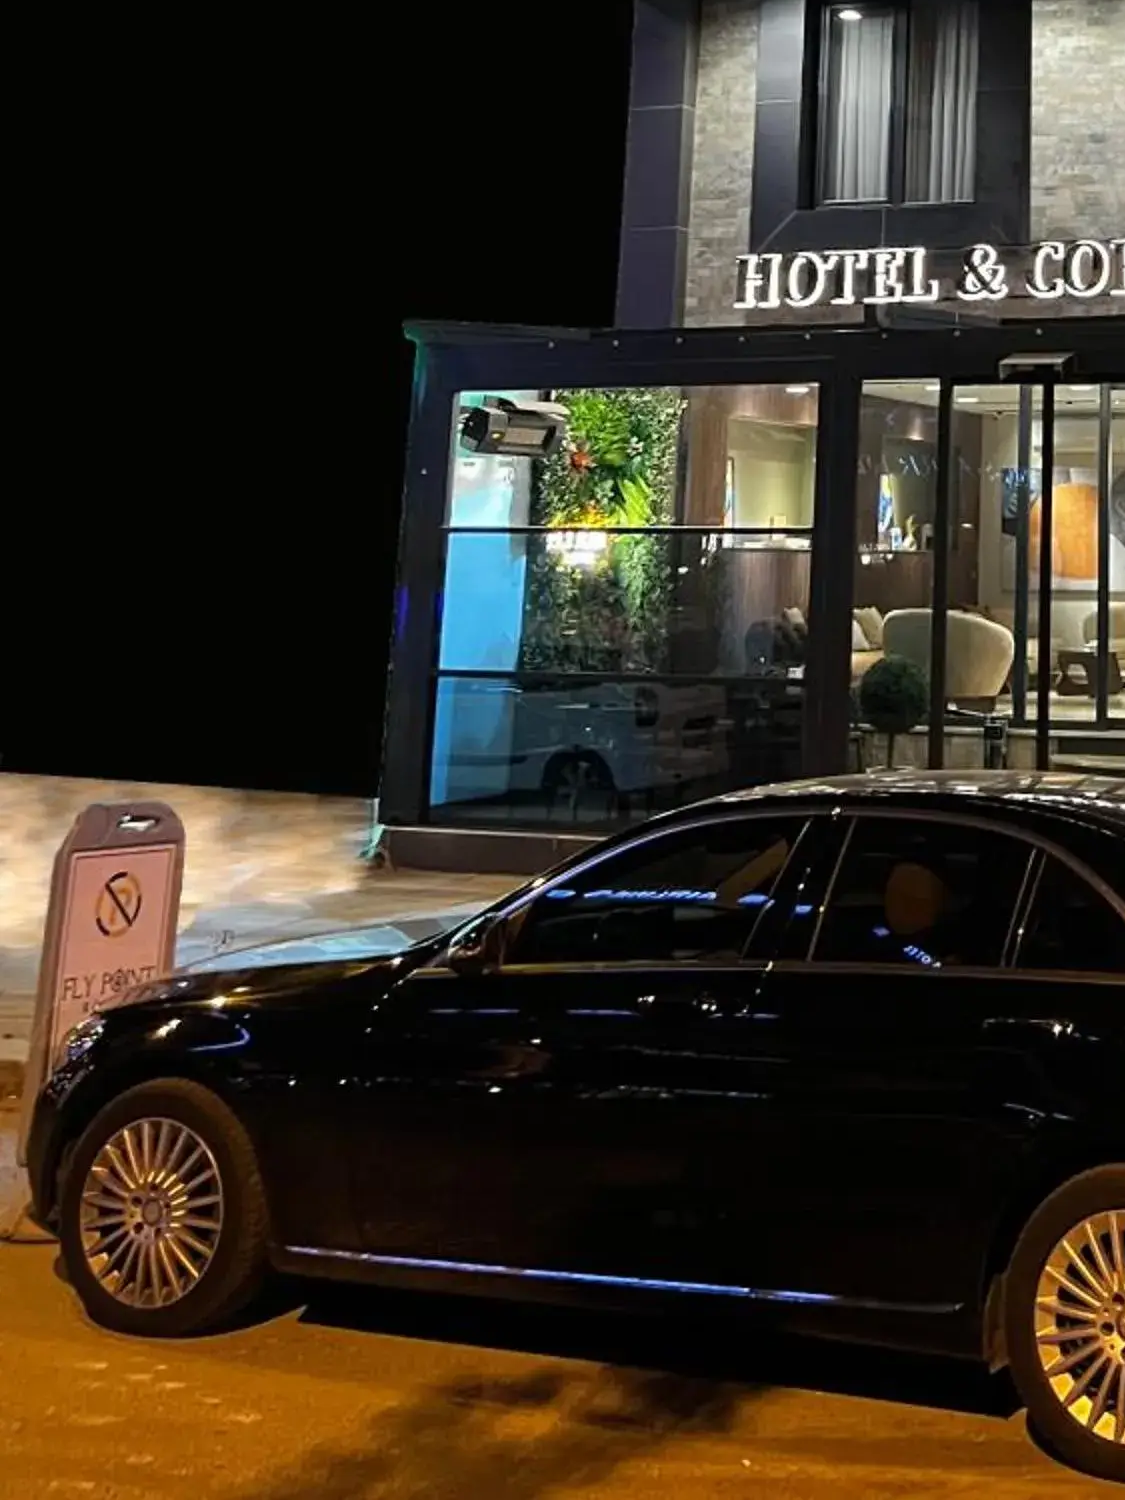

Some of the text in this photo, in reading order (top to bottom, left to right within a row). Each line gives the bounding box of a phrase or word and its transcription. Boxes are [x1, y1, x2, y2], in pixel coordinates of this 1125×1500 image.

[733, 246, 940, 310] HOTEL
[956, 243, 1010, 302] &
[62, 973, 97, 1000] FLY
